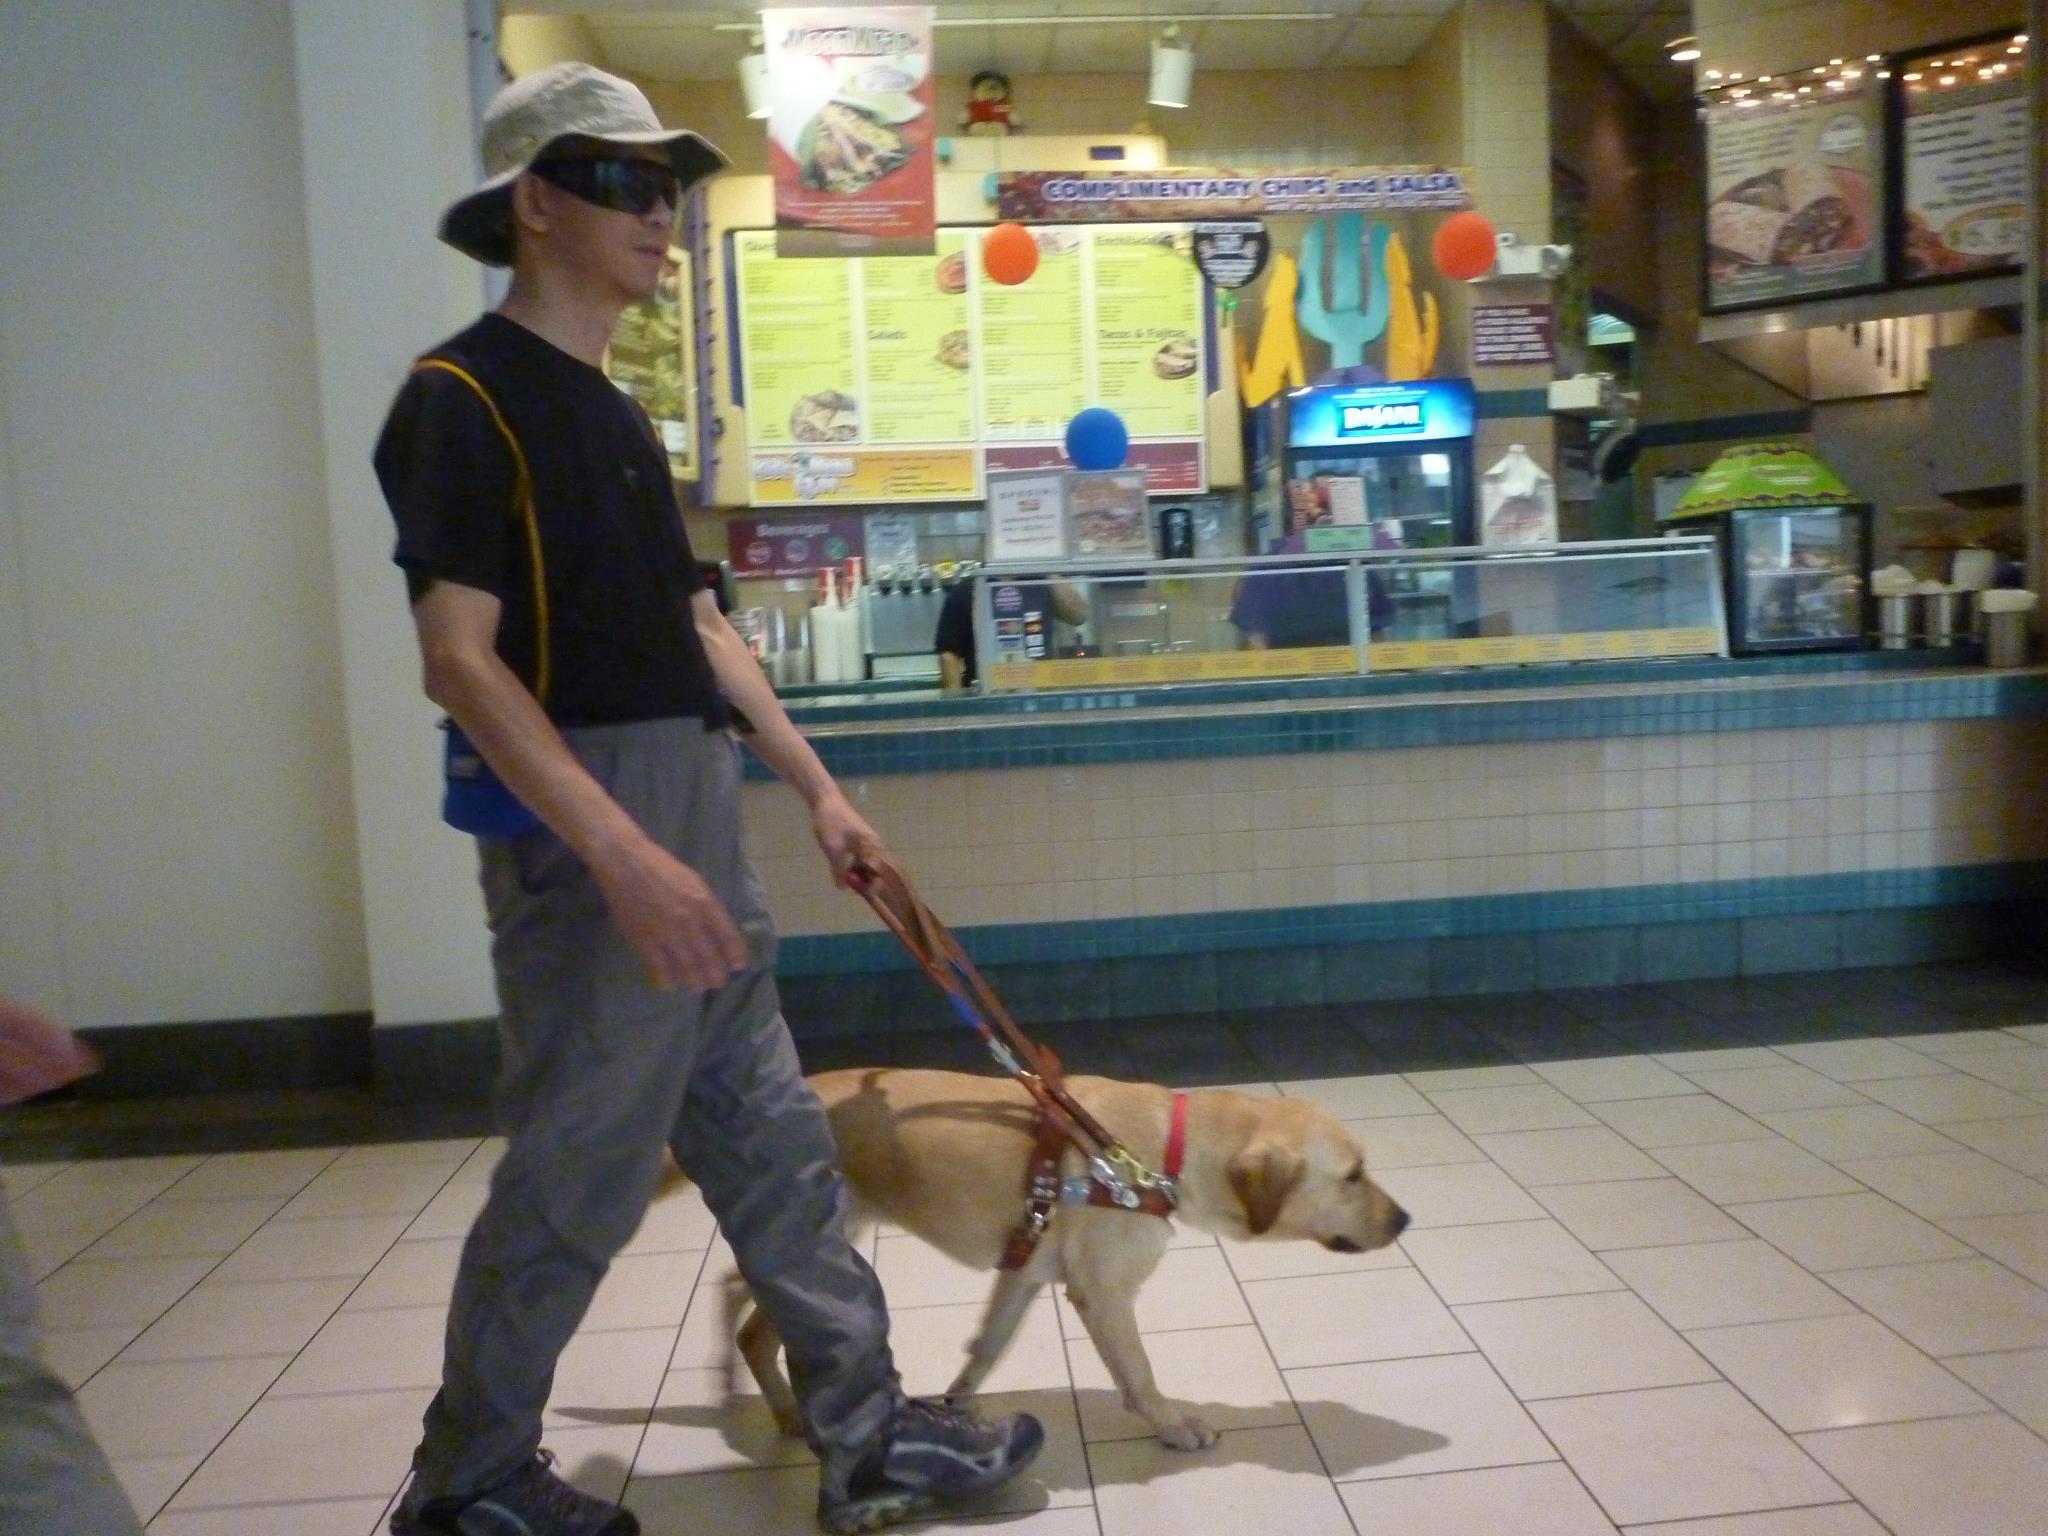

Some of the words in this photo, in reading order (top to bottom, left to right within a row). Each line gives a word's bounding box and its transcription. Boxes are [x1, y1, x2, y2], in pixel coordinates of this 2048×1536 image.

[1043, 179, 1253, 200] COMPLIMENTARY
[1261, 176, 1329, 197] CHIPS
[1335, 176, 1380, 195] and
[1387, 173, 1462, 194] SALSA
